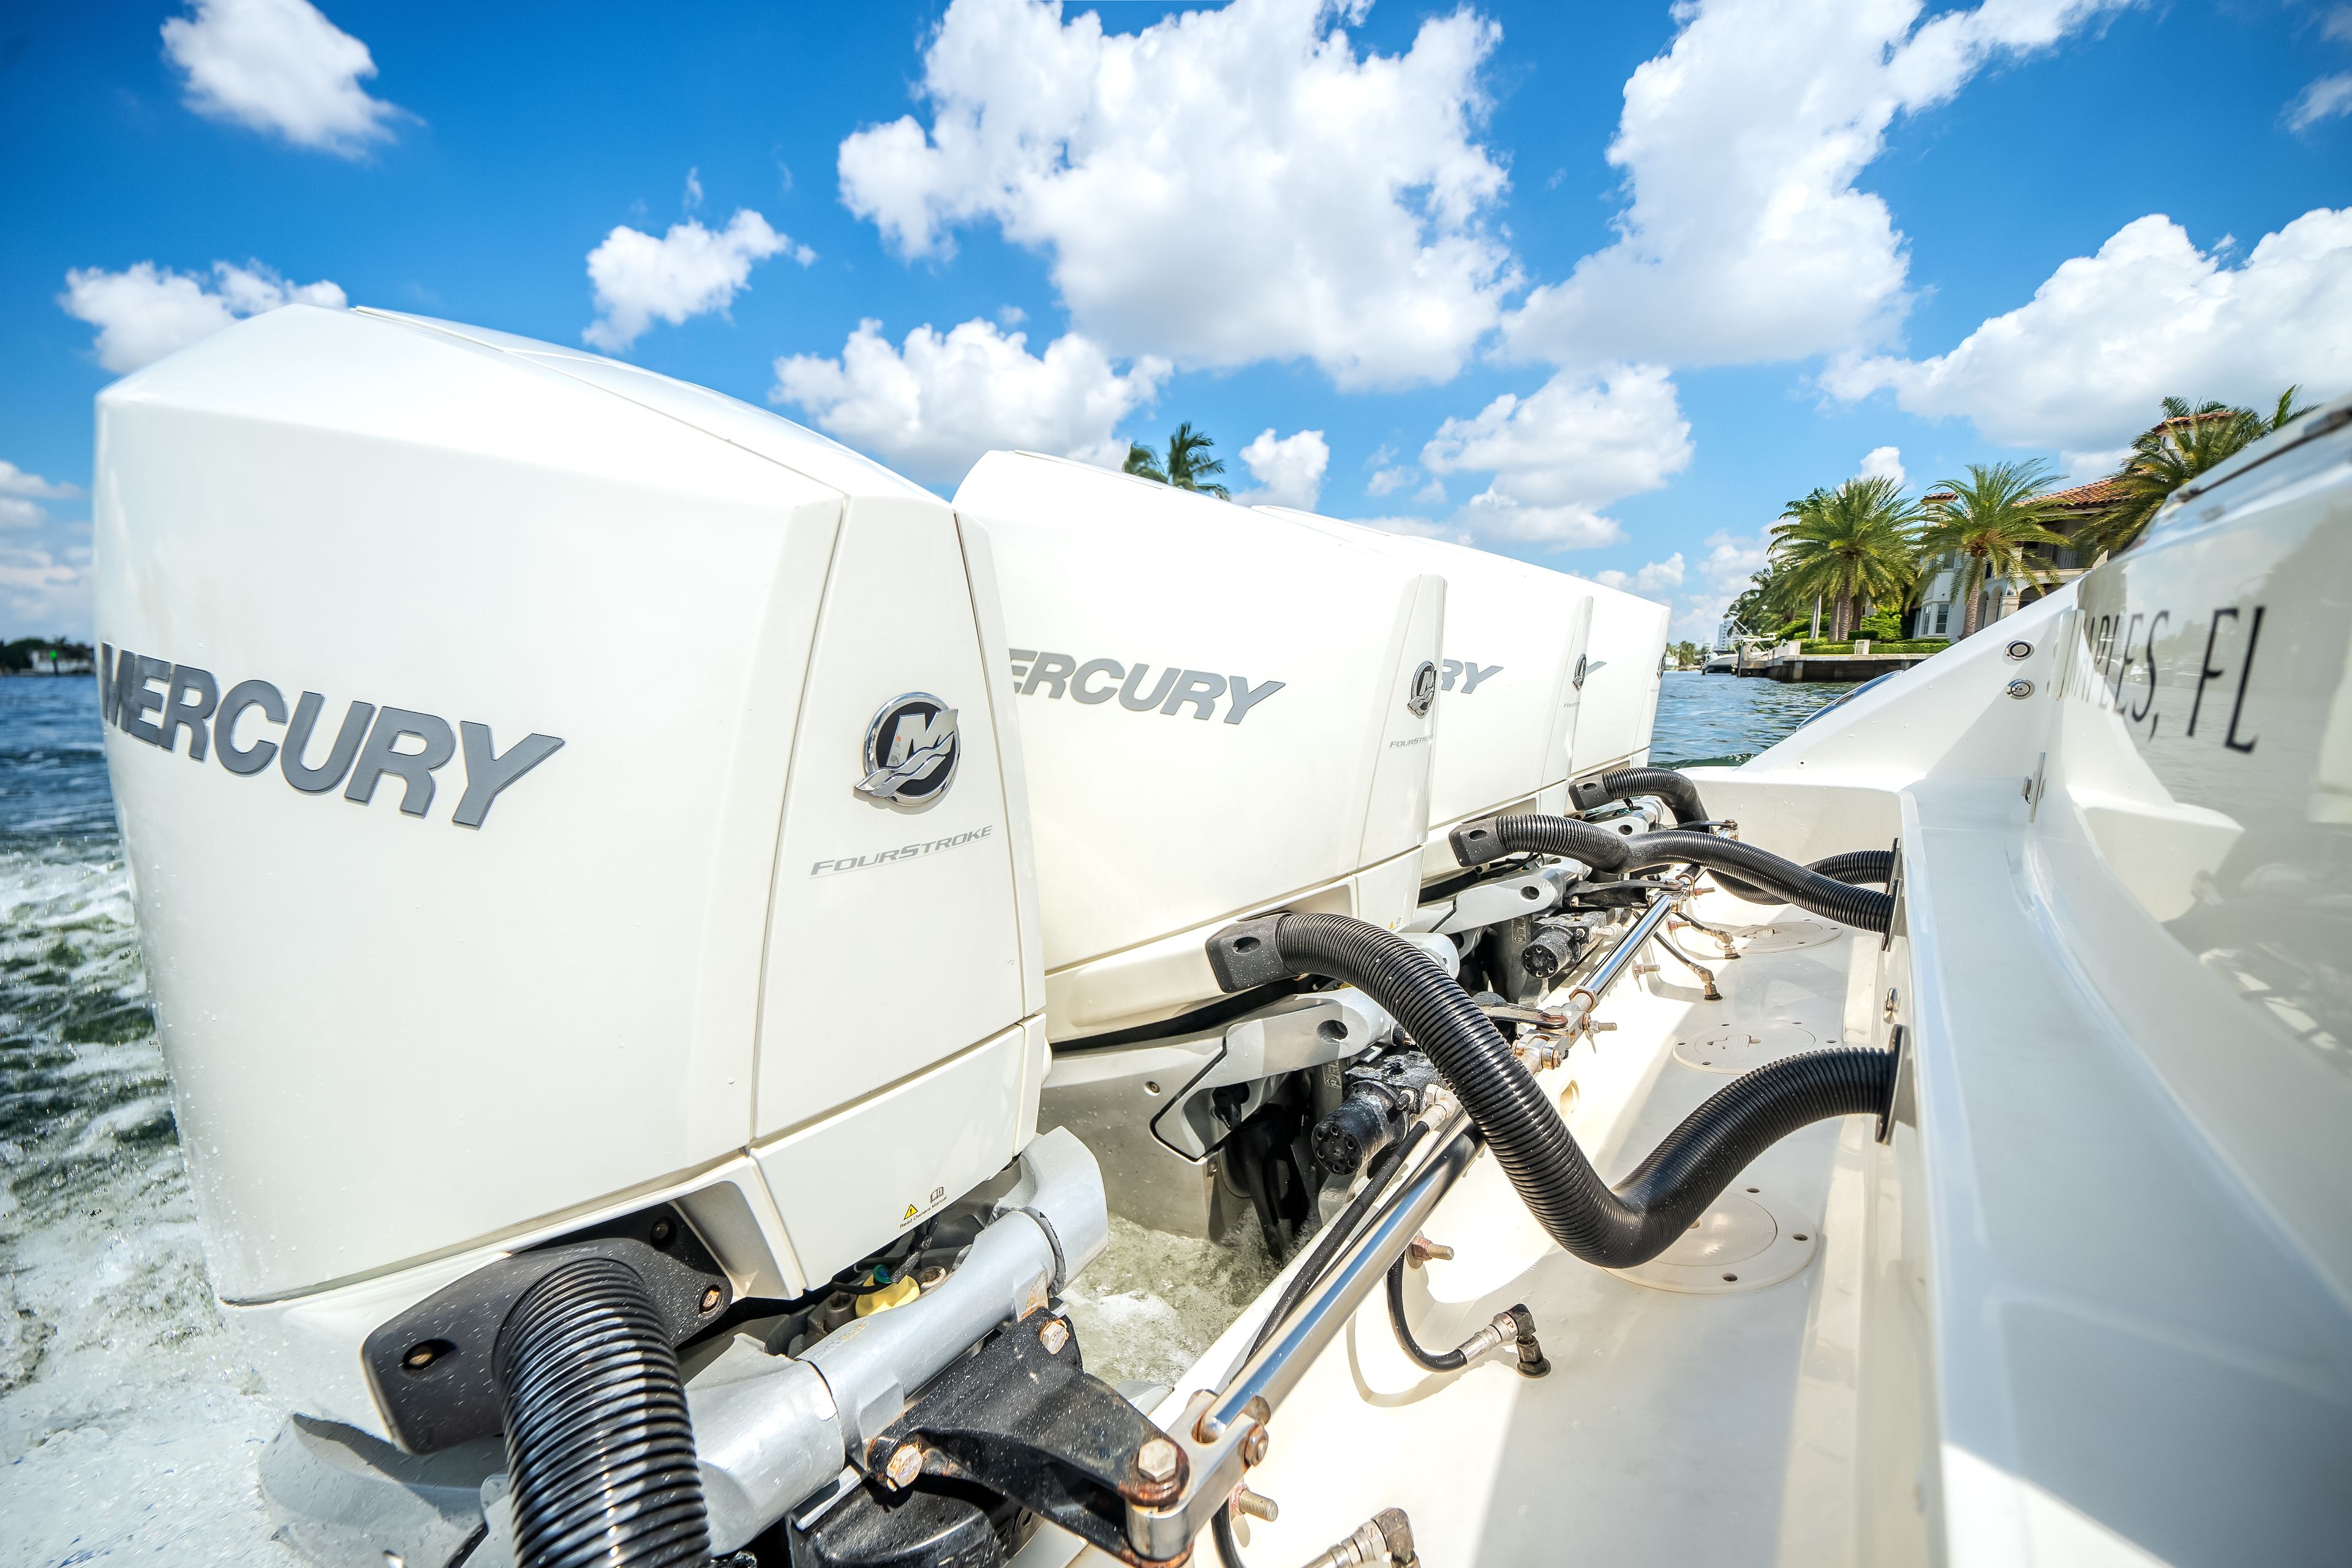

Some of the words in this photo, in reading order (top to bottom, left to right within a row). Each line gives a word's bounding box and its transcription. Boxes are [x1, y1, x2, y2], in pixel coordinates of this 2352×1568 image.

[1008, 648, 1286, 725] ERCURY
[2187, 605, 2266, 754] FL
[101, 642, 565, 830] MERCURY
[810, 825, 993, 876] FOURSTROKE
[900, 1218, 913, 1229] Read
[913, 1207, 931, 1221] Owners
[932, 1195, 948, 1208] Manual
